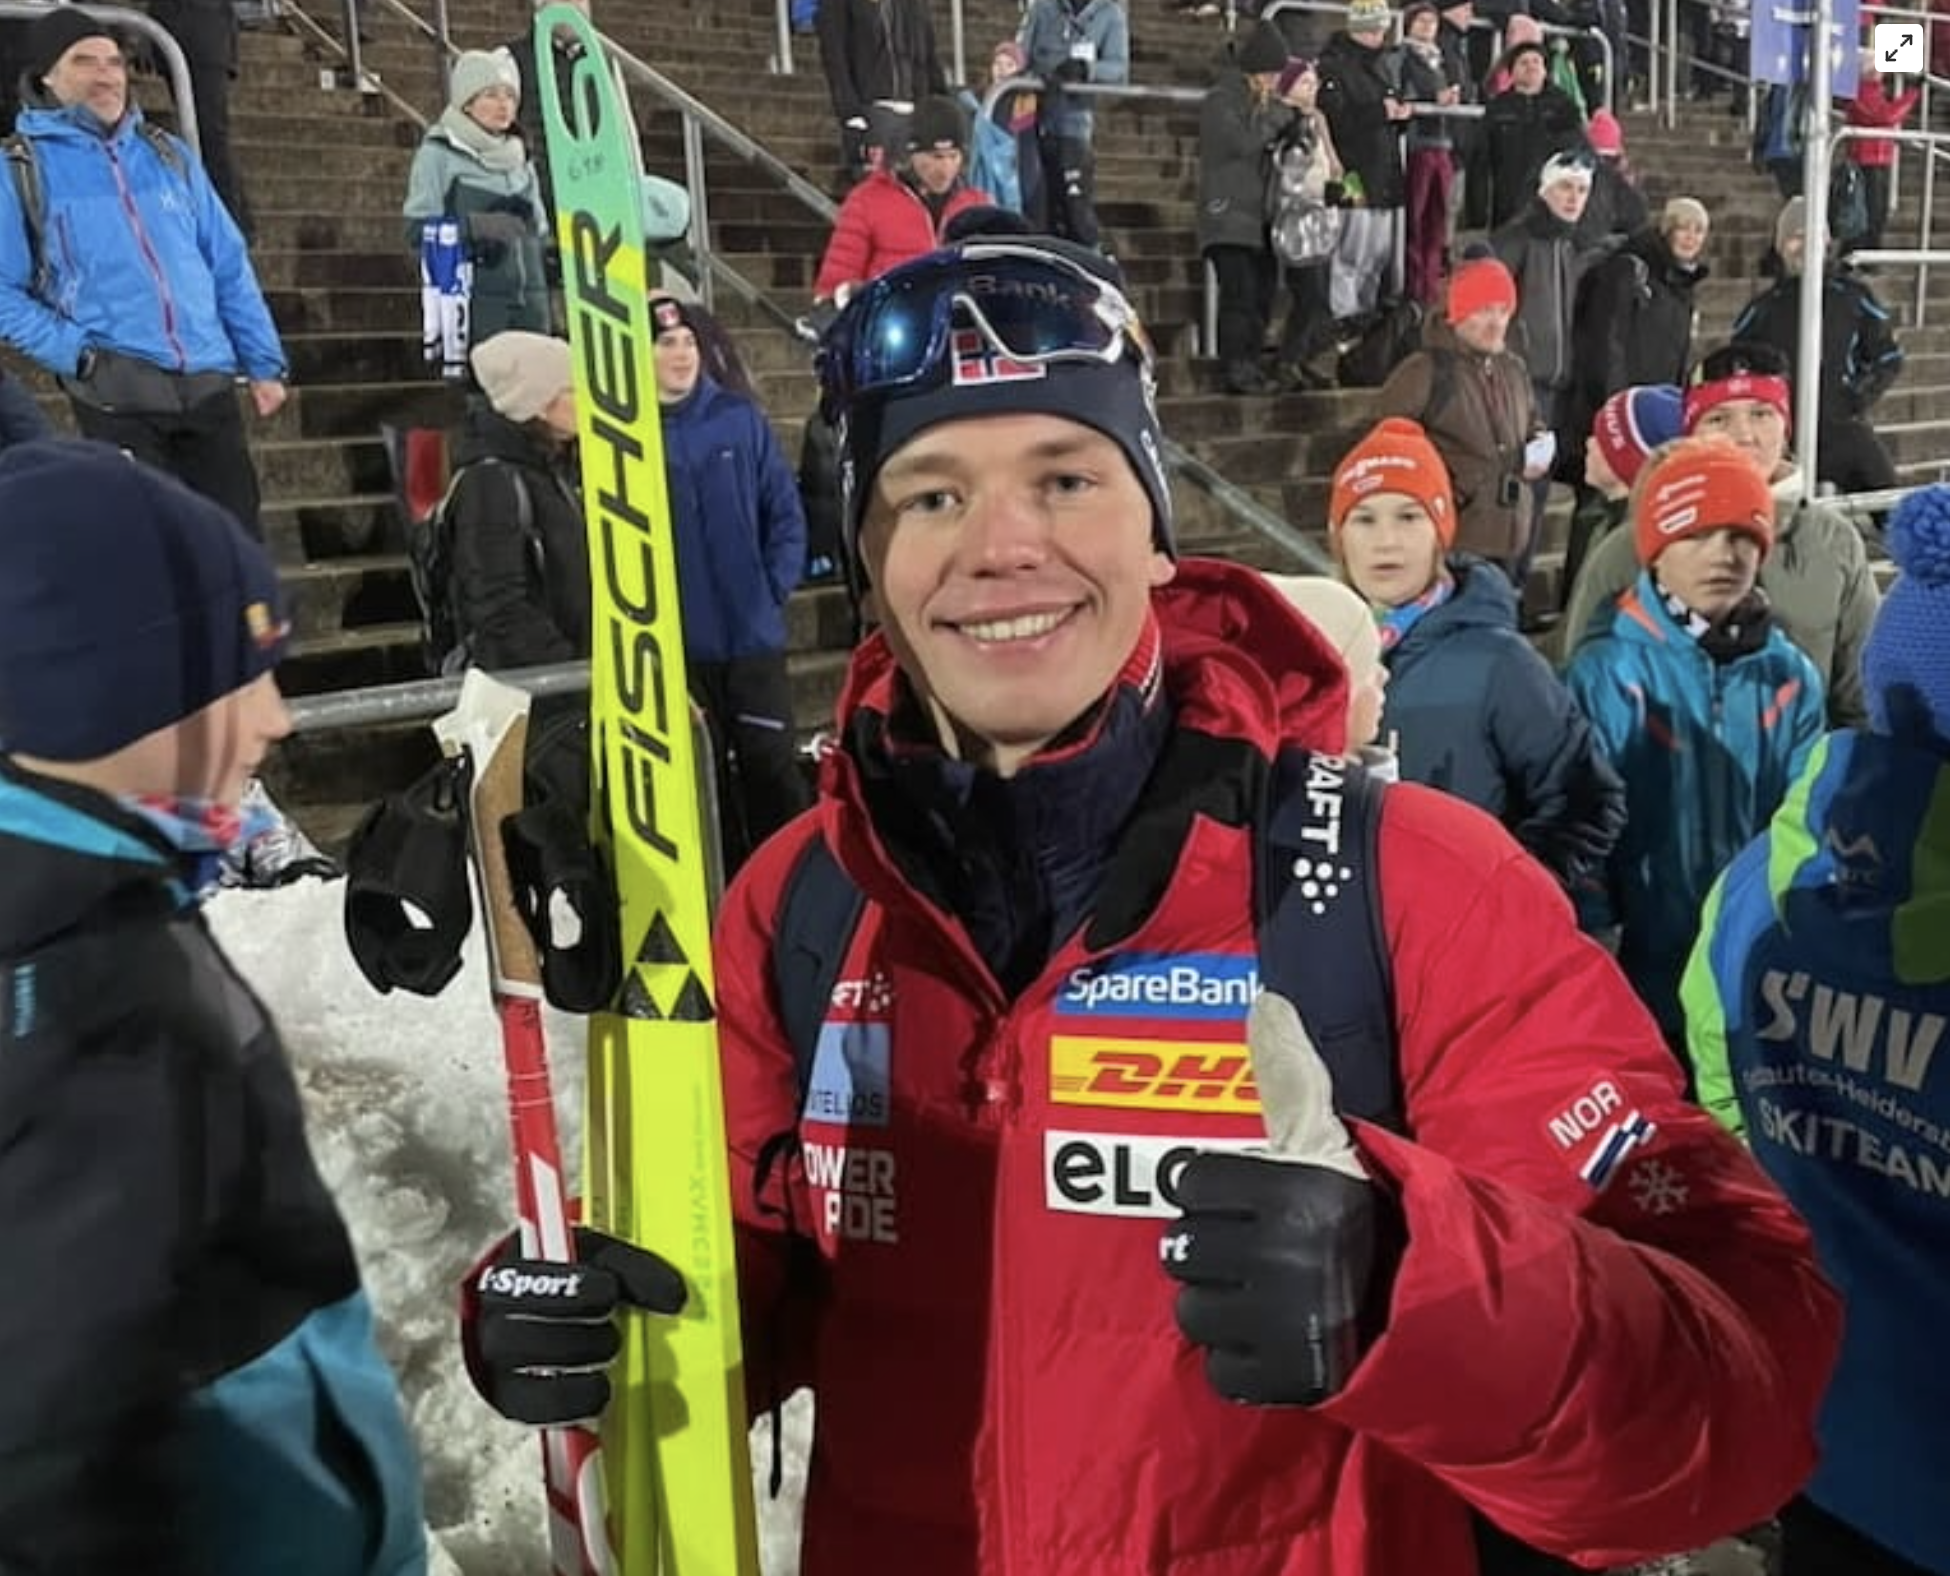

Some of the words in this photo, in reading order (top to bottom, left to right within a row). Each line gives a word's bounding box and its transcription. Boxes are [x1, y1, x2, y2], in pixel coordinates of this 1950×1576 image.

[572, 210, 679, 862] FISCHER
[1300, 750, 1346, 854] RAFT
[1755, 968, 1947, 1093] SWV
[1548, 1080, 1622, 1148] NOR
